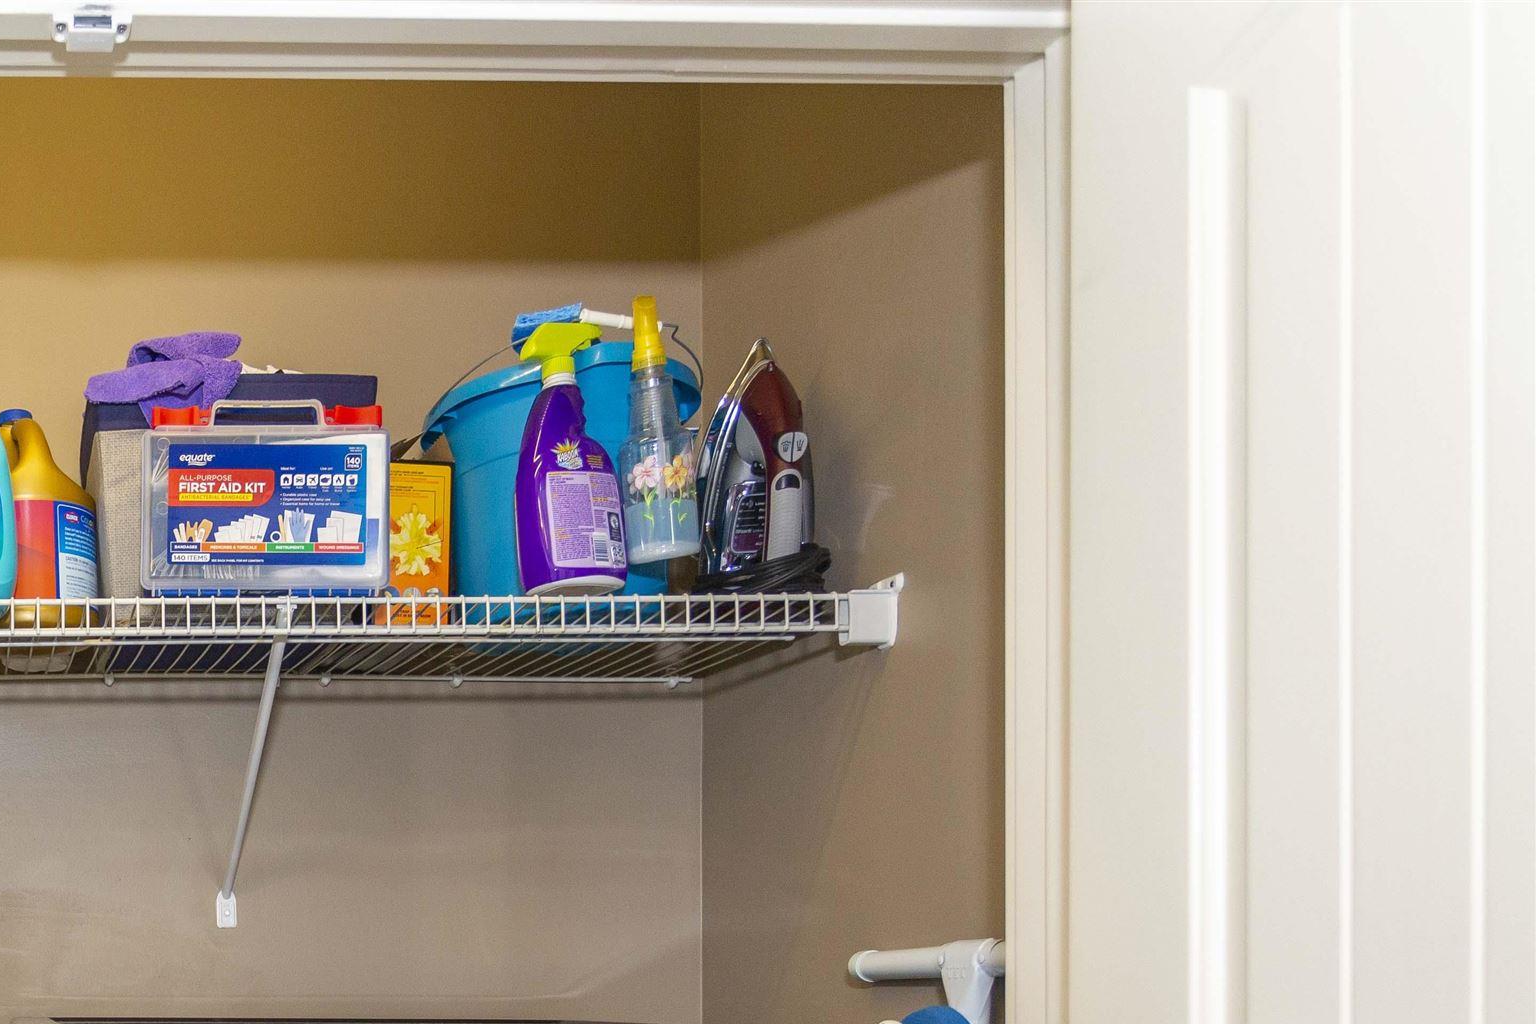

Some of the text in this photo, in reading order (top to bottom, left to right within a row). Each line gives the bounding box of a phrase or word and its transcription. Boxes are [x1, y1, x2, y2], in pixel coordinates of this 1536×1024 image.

[179, 452, 212, 464] equate
[346, 456, 361, 465] 140
[179, 474, 232, 482] ALL-PURPOSE
[178, 482, 266, 493] FIRST AID KIT
